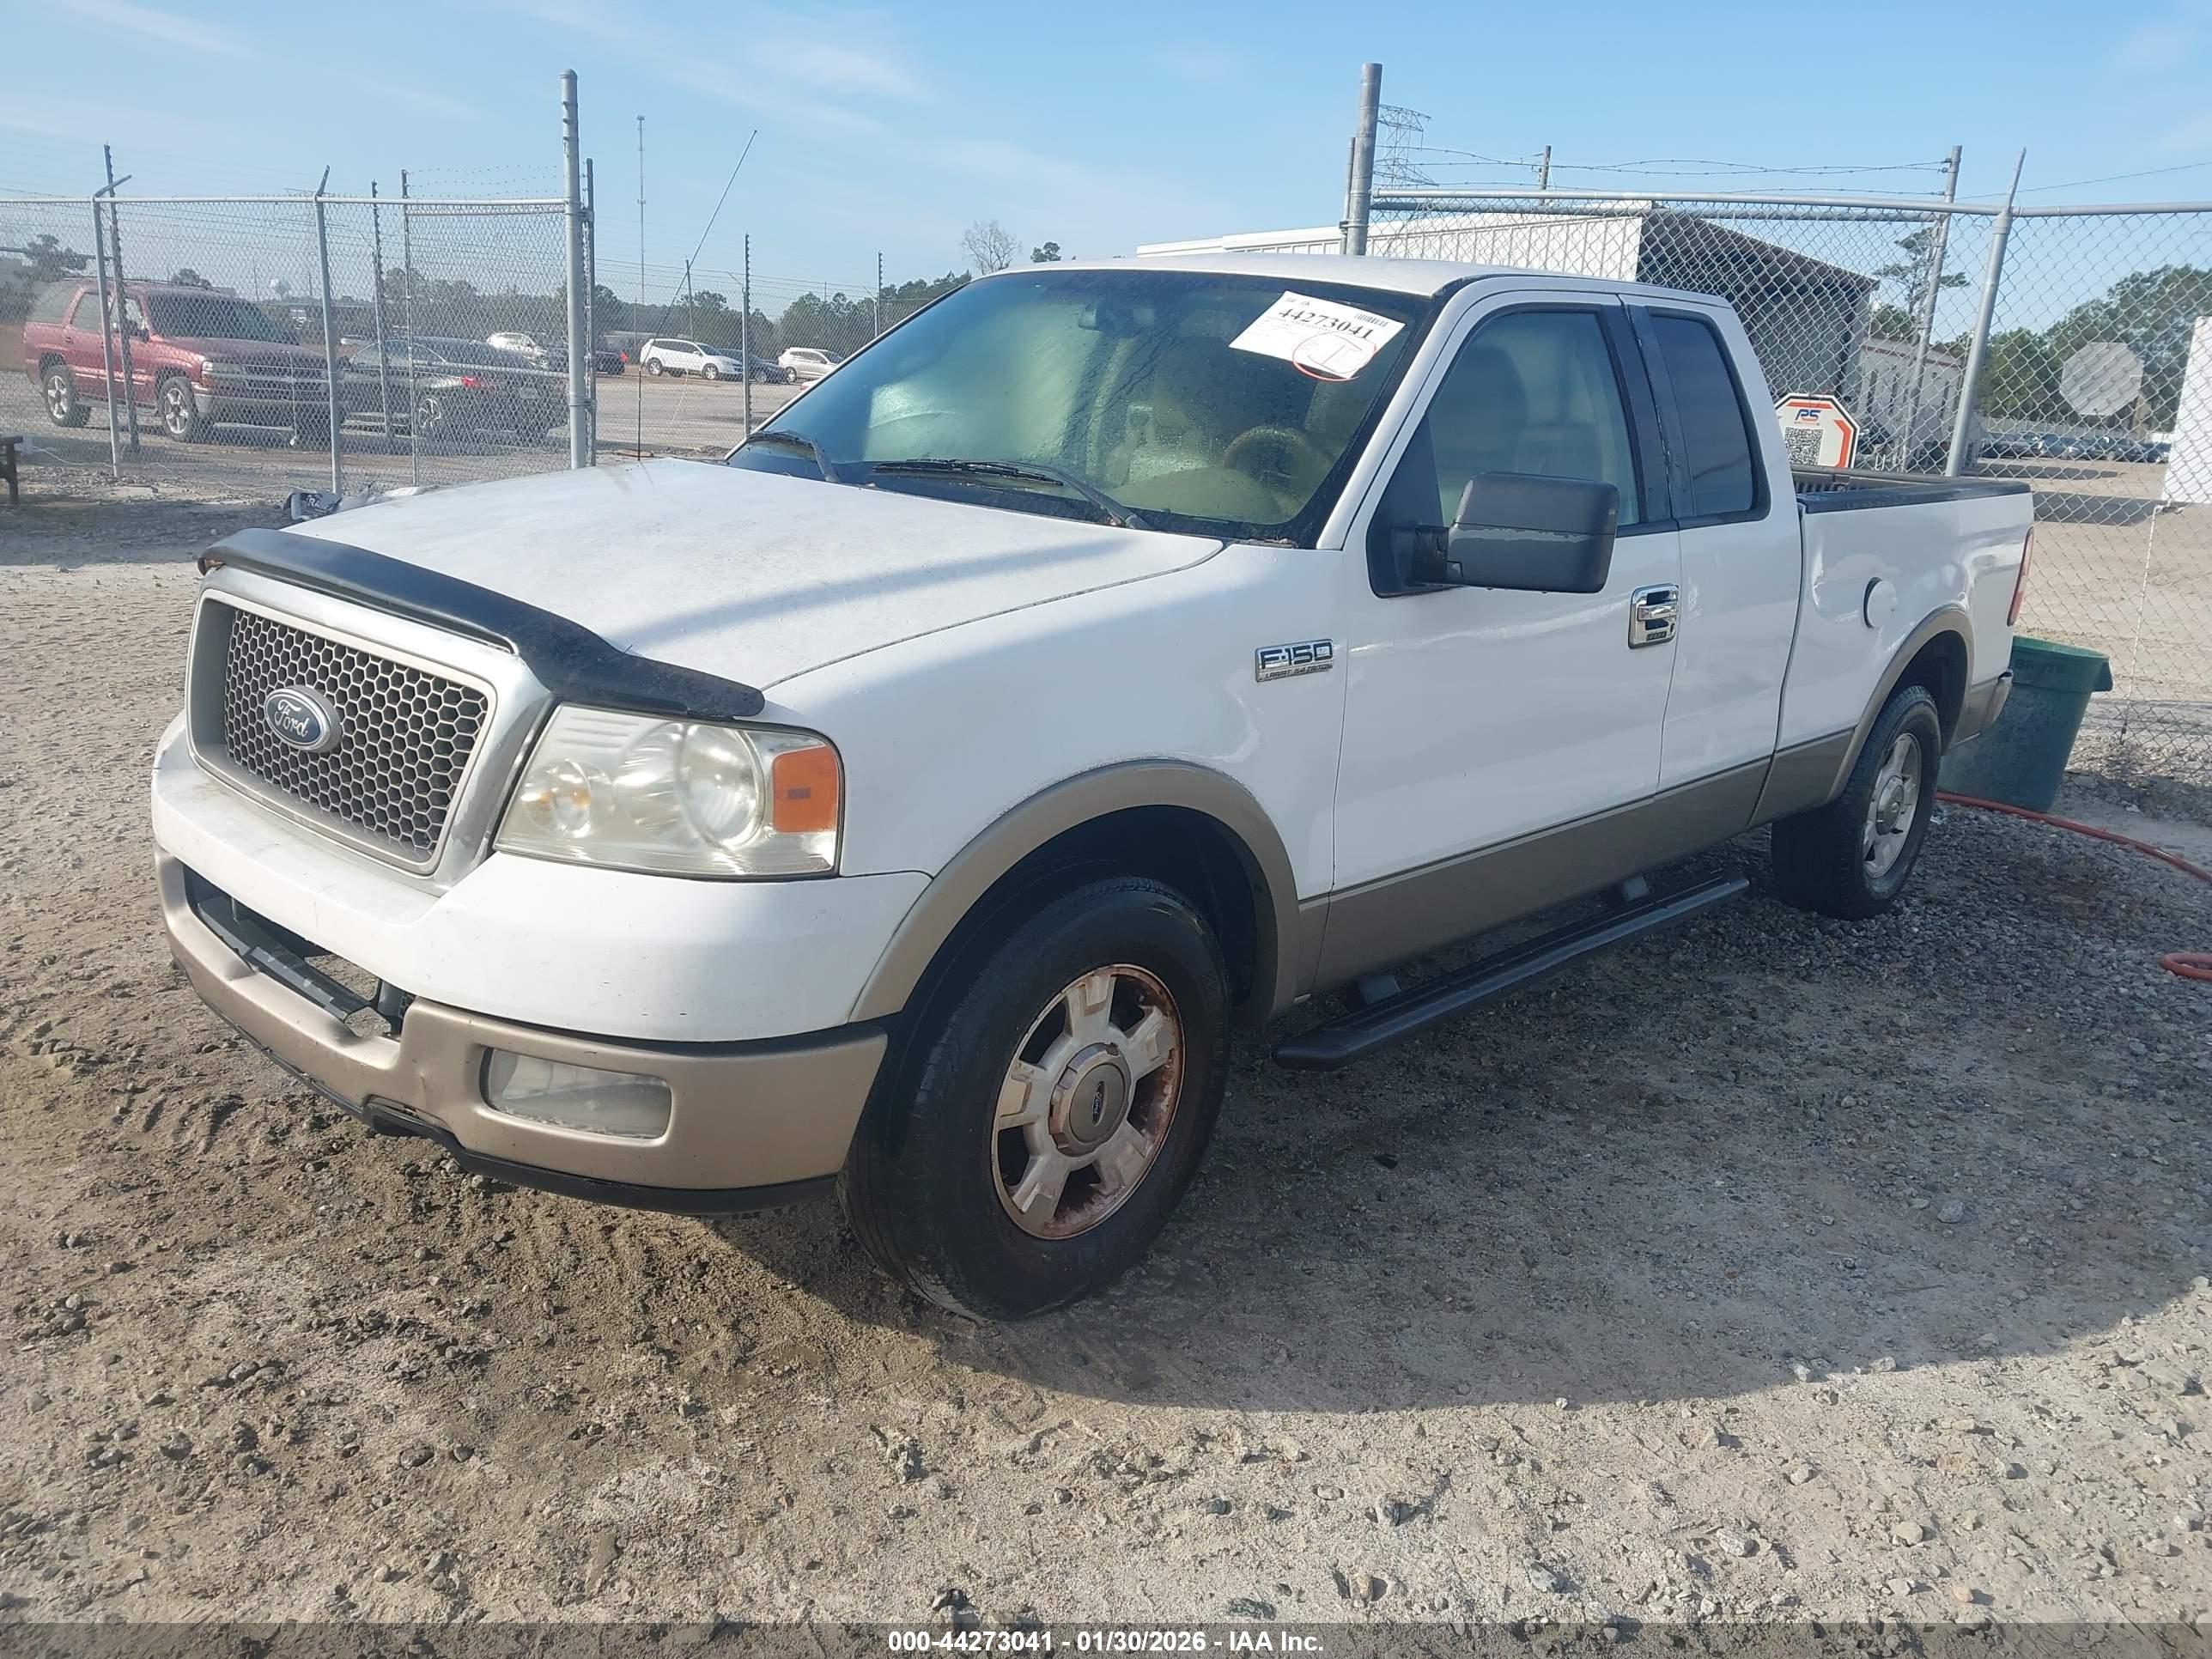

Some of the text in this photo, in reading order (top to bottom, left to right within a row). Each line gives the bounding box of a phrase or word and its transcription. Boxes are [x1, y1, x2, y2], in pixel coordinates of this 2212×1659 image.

[1278, 307, 1375, 340] 44273041
[1260, 641, 1334, 670] F-150
[1266, 669, 1291, 678] LARIAT
[274, 699, 310, 738] Ford
